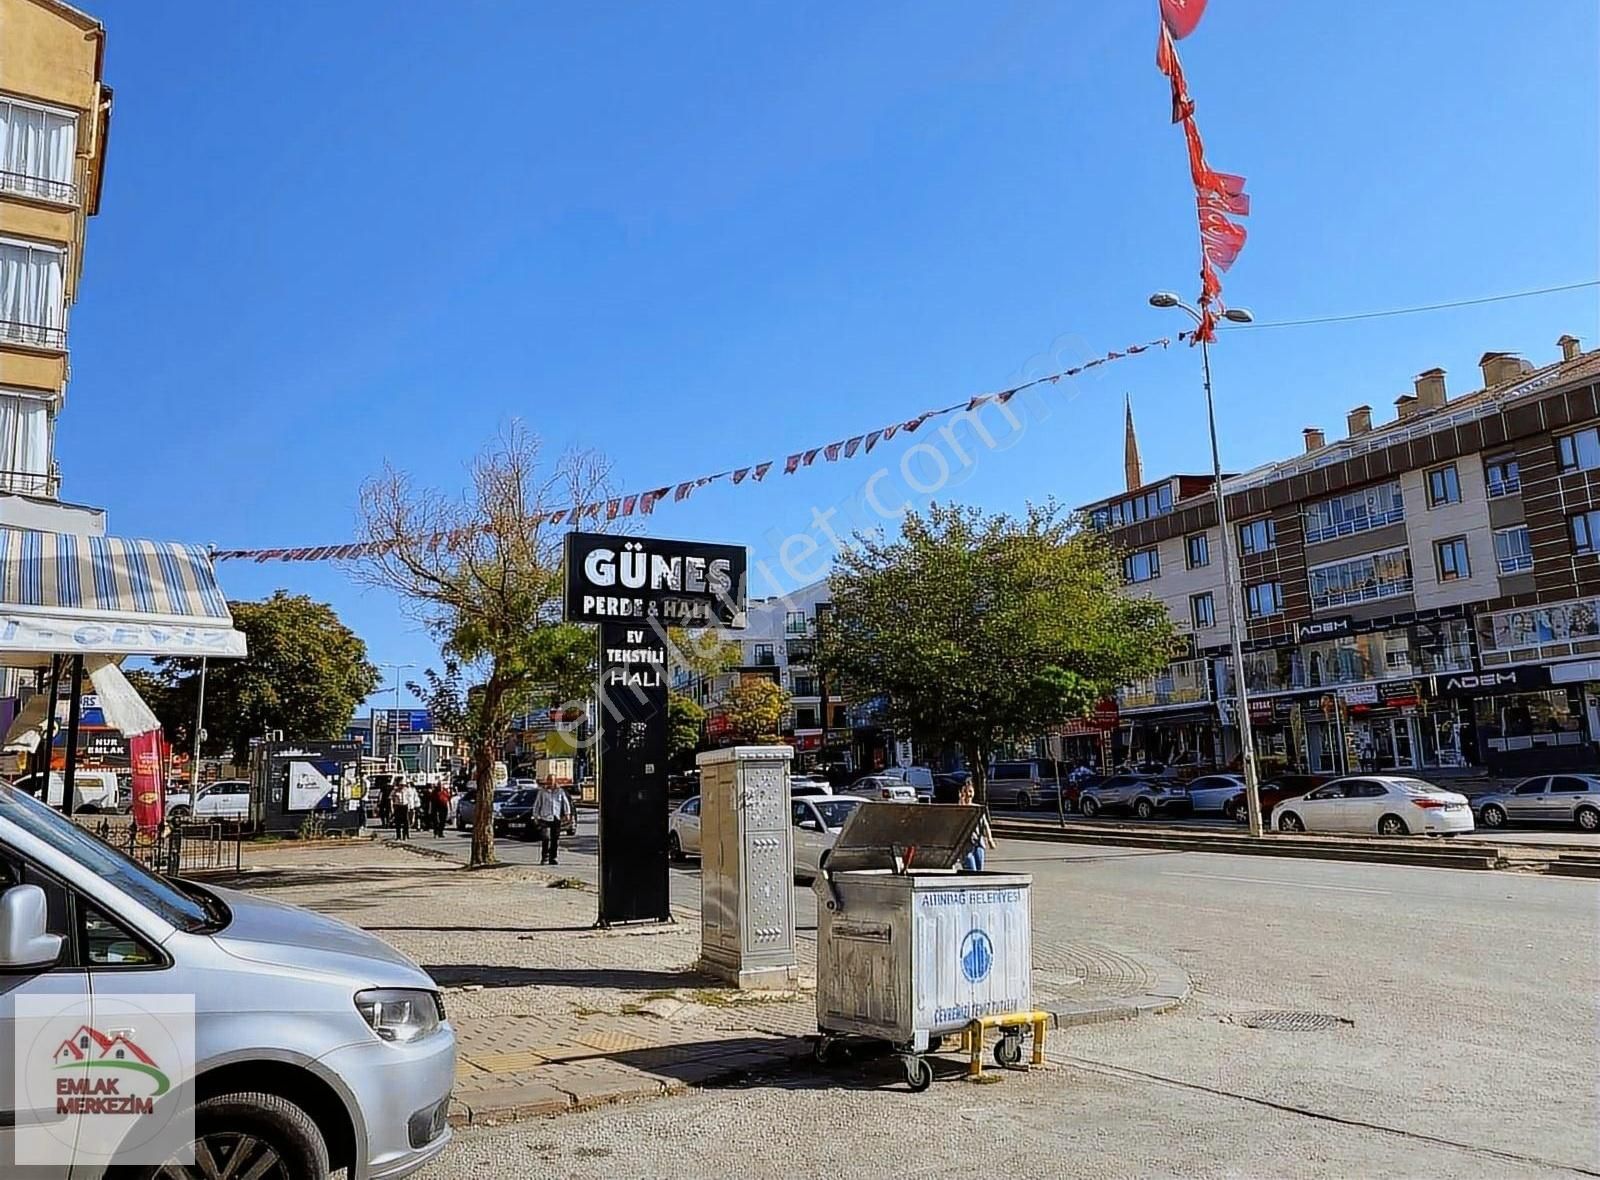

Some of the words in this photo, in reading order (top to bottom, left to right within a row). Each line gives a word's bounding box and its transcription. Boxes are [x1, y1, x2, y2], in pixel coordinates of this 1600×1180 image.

[583, 595, 643, 617] PERDE
[647, 600, 659, 617] &
[1300, 620, 1347, 636] ADEM
[627, 630, 643, 644] EV
[606, 647, 664, 664] TEKSTİLİ
[611, 671, 660, 687] HALI
[1447, 671, 1517, 690] ADEM
[87, 746, 124, 754] EMLAK
